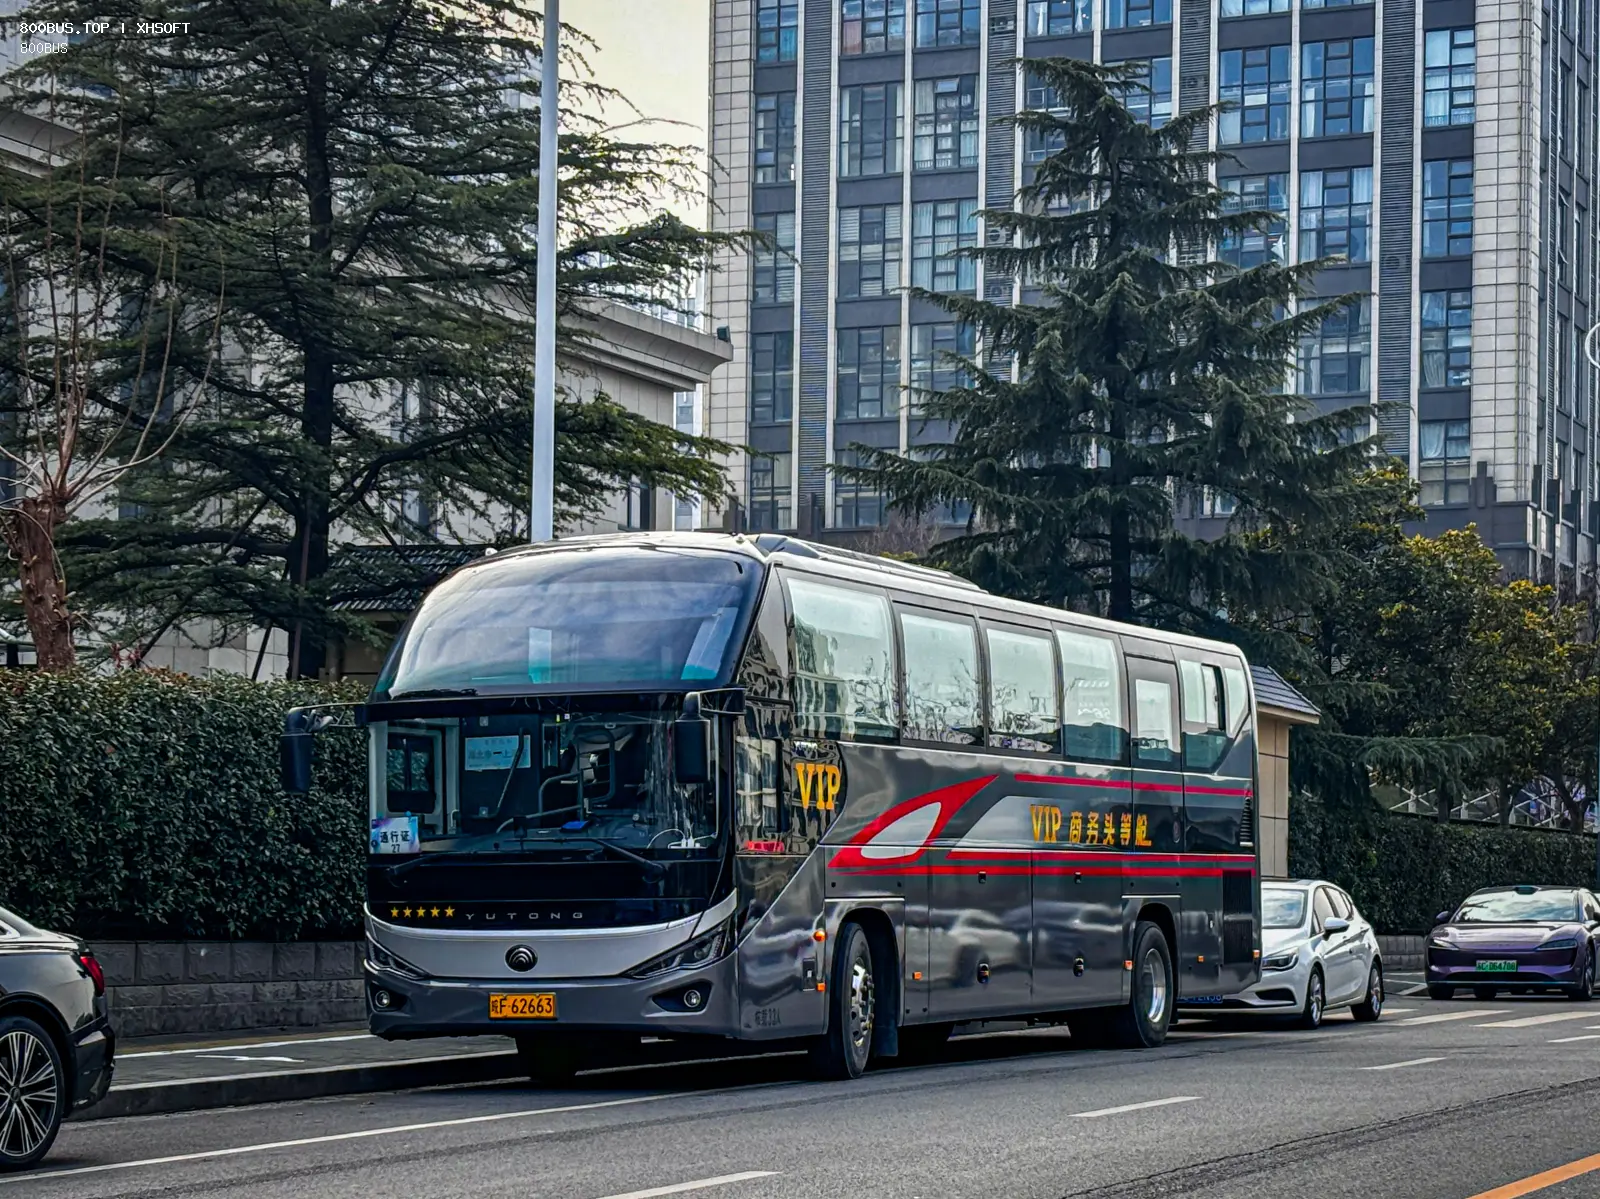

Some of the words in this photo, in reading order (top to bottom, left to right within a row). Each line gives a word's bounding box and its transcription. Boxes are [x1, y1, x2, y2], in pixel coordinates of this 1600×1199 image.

[795, 762, 841, 810] VIP
[1029, 804, 1063, 844] VIP
[1069, 811, 1152, 847] 商务头等舱
[380, 830, 411, 843] 通行证
[391, 843, 400, 854] 27
[465, 912, 583, 921] YUTONG
